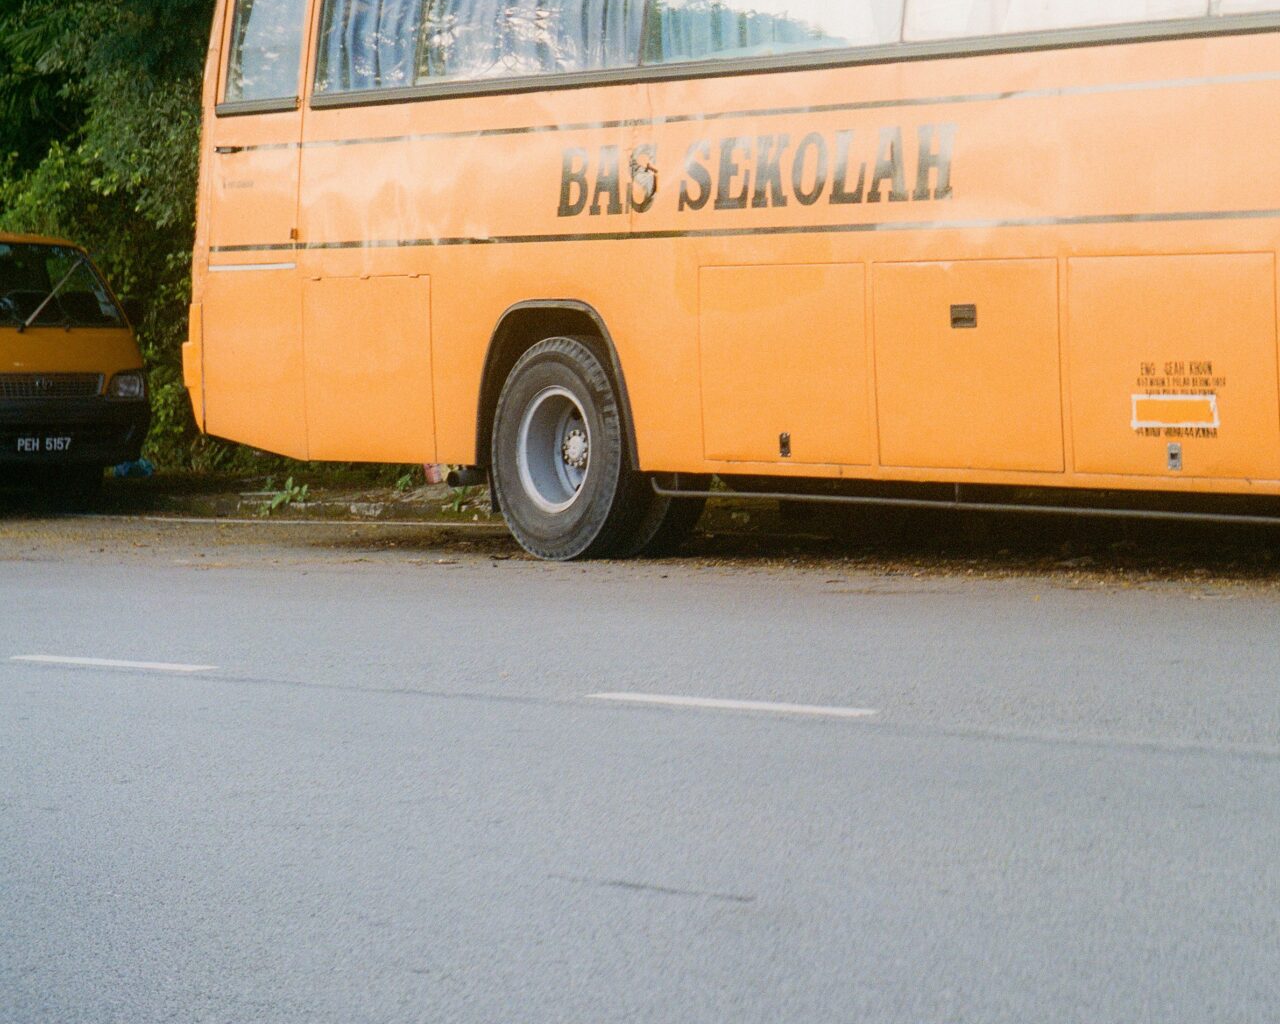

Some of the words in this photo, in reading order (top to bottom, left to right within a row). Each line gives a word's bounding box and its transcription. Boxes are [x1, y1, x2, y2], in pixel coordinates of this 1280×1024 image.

[557, 143, 659, 217] BAS
[677, 122, 958, 212] SEKOLAH
[17, 437, 40, 452] PEH
[45, 437, 72, 451] 5157
